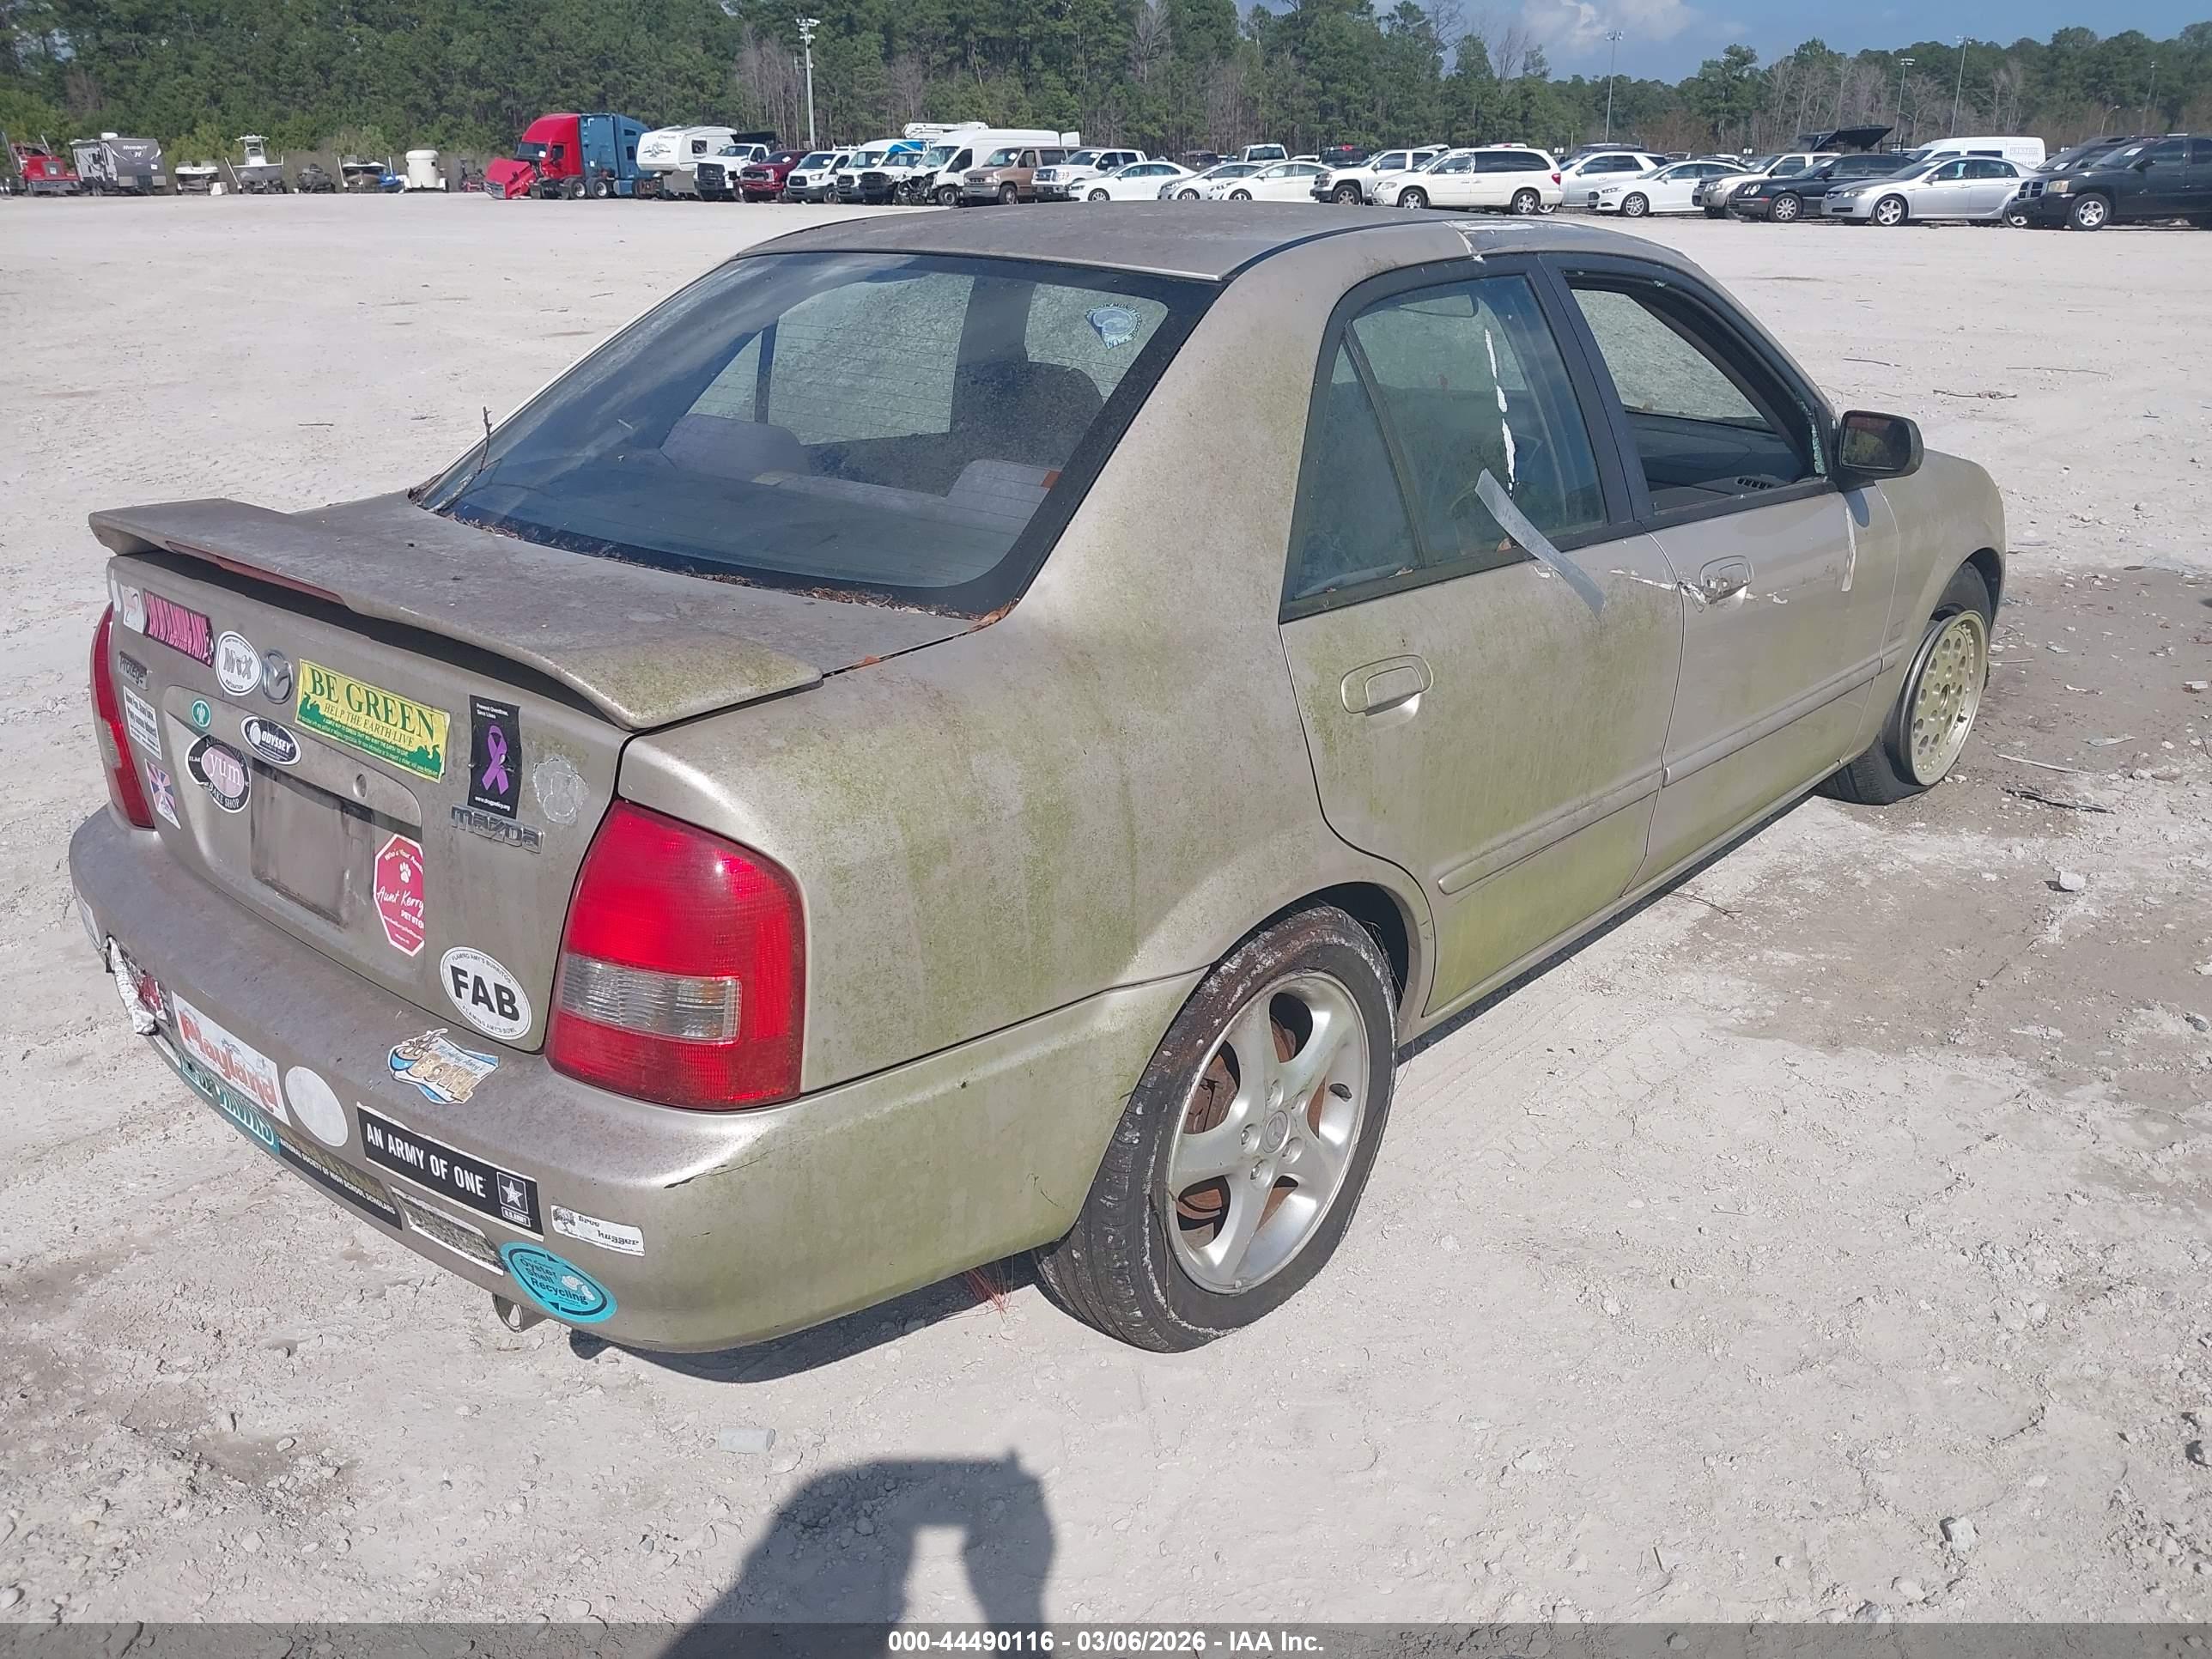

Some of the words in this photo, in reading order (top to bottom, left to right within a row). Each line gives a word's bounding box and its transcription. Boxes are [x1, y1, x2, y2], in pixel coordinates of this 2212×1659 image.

[309, 668, 339, 703] BE
[345, 683, 434, 743] GREEN
[324, 702, 345, 719] HELP
[346, 709, 364, 727] THE
[363, 719, 393, 738] EARTH
[393, 727, 415, 748] LIVE
[261, 731, 290, 754] ODYSSEY
[209, 752, 242, 787] yum
[208, 782, 225, 805] BAKE
[224, 797, 240, 809] SHOP
[377, 885, 400, 903] Aunt
[401, 909, 412, 923] PET
[450, 964, 520, 1022] FAB
[179, 1010, 280, 1113] Playland
[366, 1122, 385, 1151] AN
[387, 1132, 425, 1170] ARMY
[429, 1153, 448, 1181] OF
[454, 1166, 486, 1199] ONE
[322, 1166, 329, 1176] OF
[343, 1178, 366, 1199] SCHOOL
[597, 1229, 640, 1247] hugger
[520, 1258, 557, 1279] Oyster
[530, 1276, 589, 1306] Recycling
